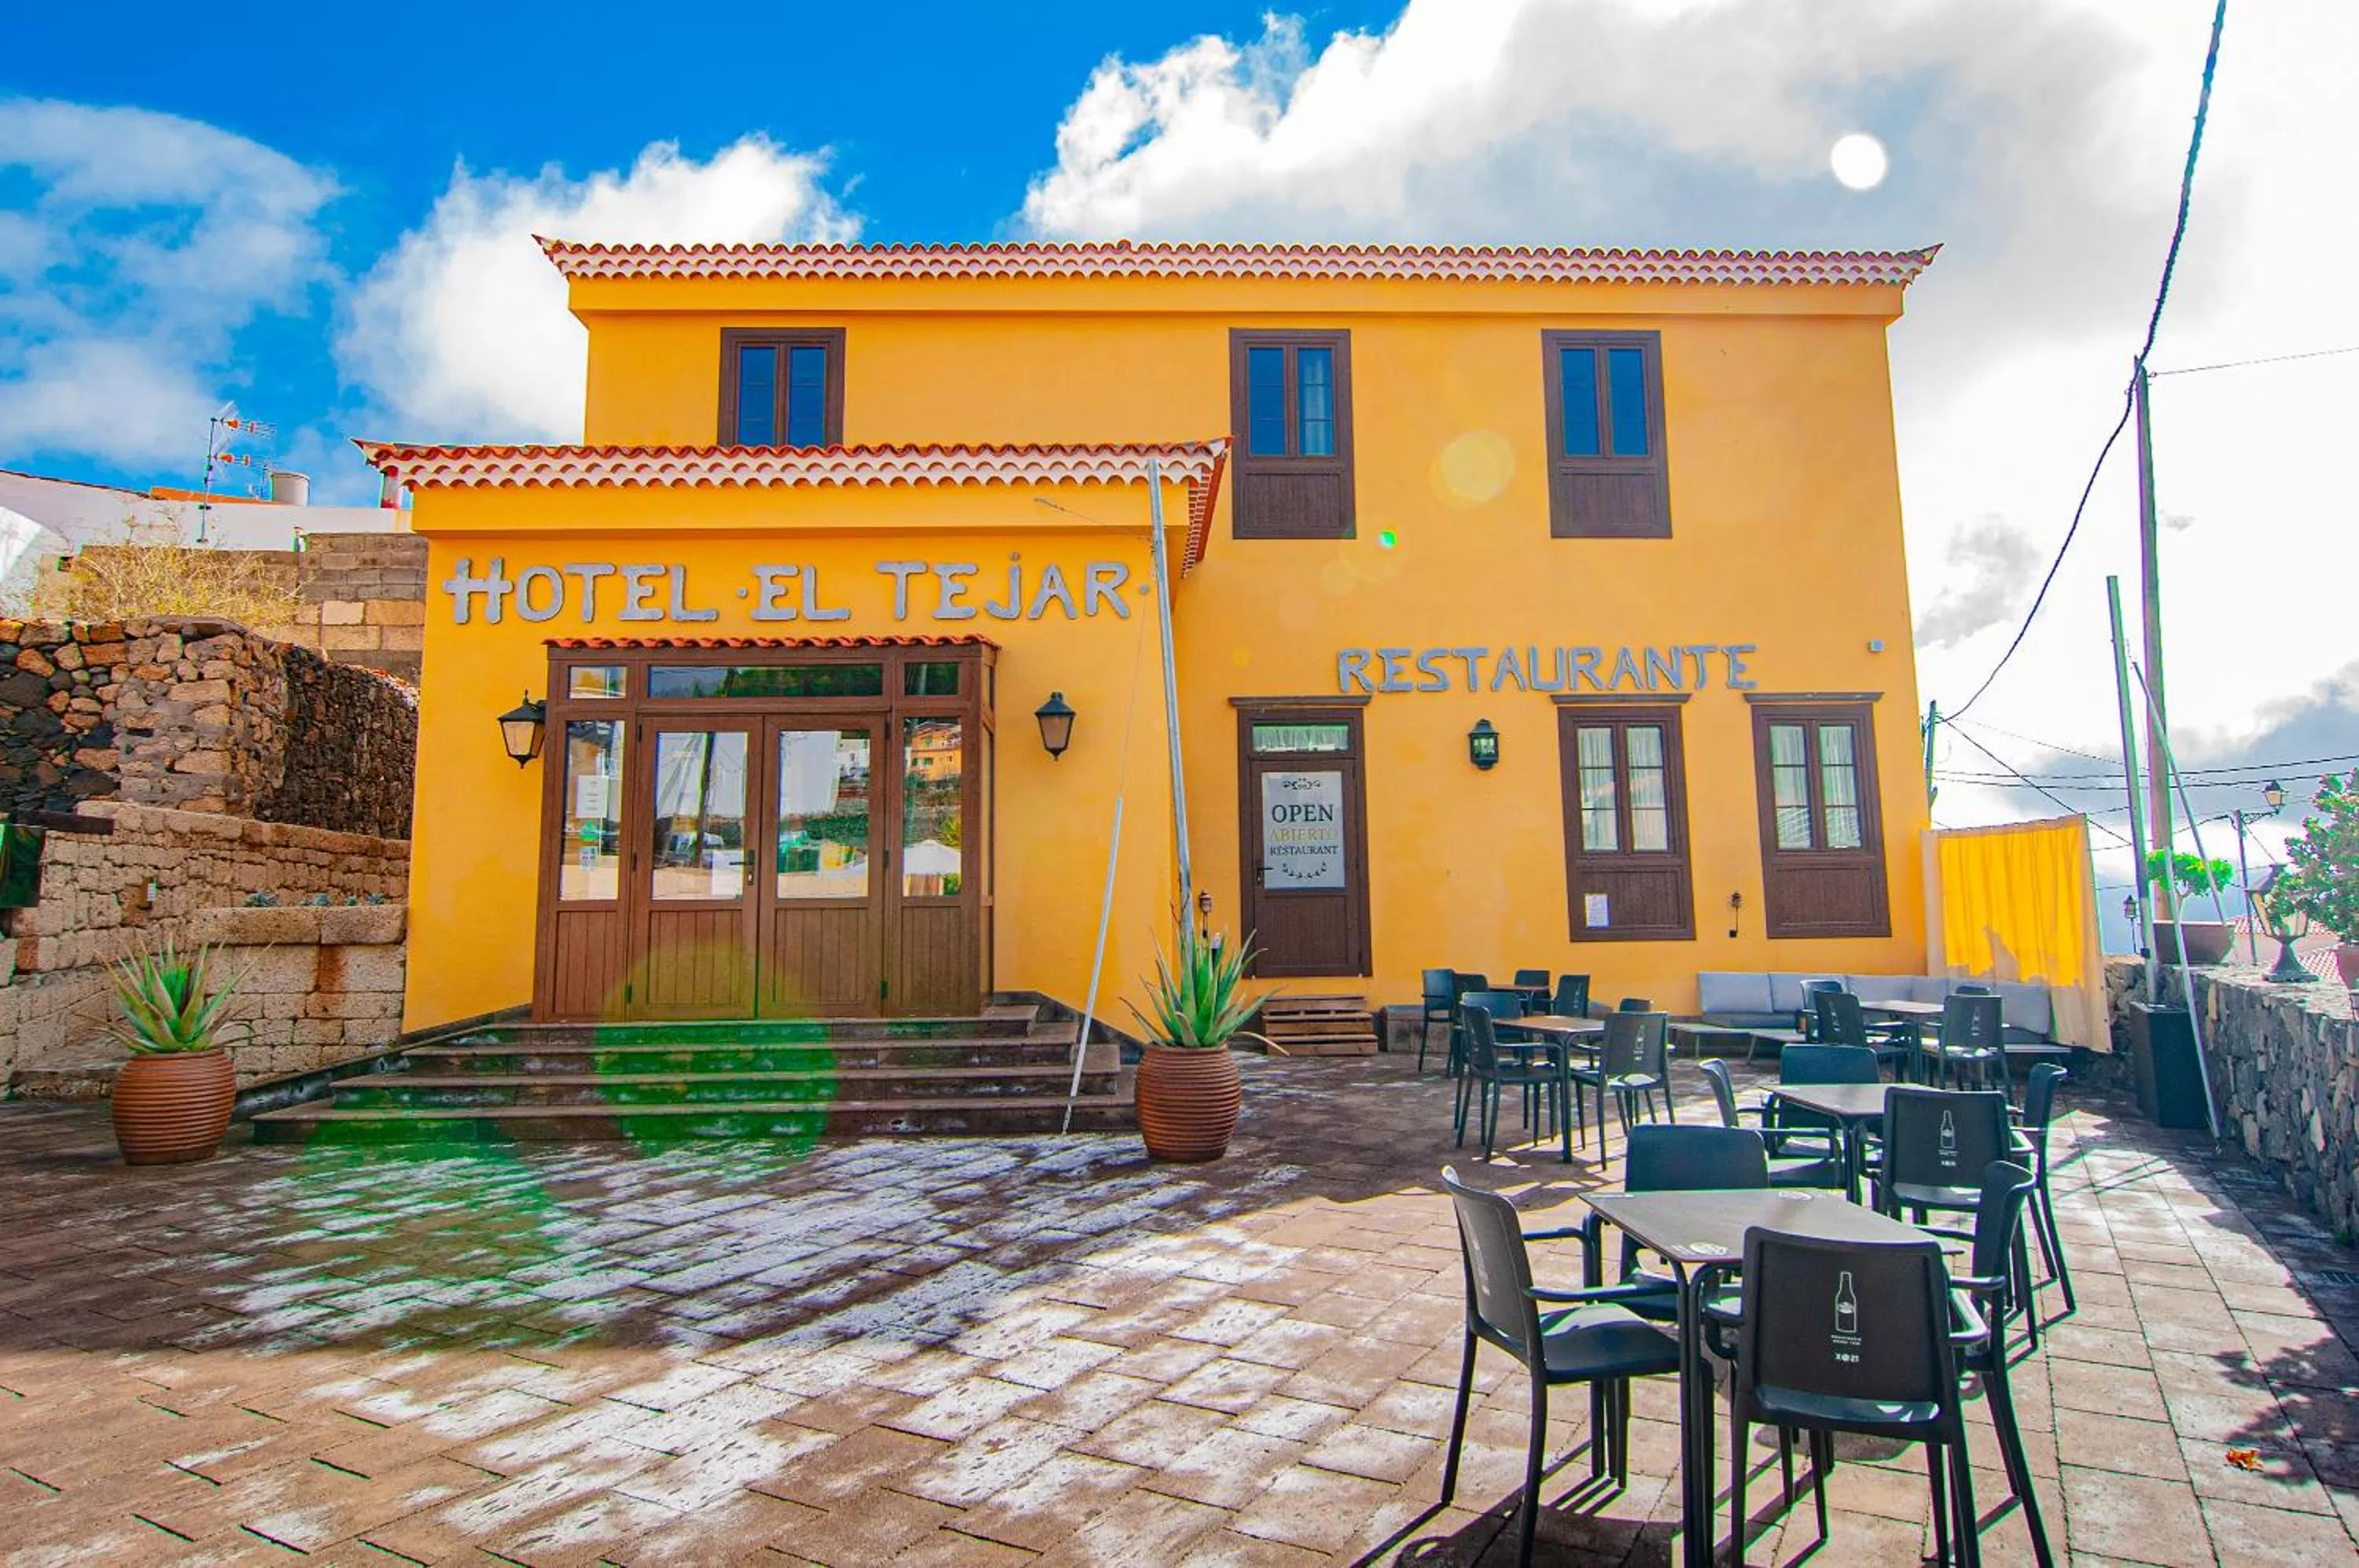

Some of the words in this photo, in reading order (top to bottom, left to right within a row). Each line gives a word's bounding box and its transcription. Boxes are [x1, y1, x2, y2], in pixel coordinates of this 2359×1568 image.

[442, 556, 719, 625] HOTEL
[1337, 644, 1758, 694] RESTAURANTE
[1272, 804, 1334, 823] OPEN
[1270, 827, 1338, 842] ABIERTO
[1270, 845, 1338, 856] RESTAURANT
